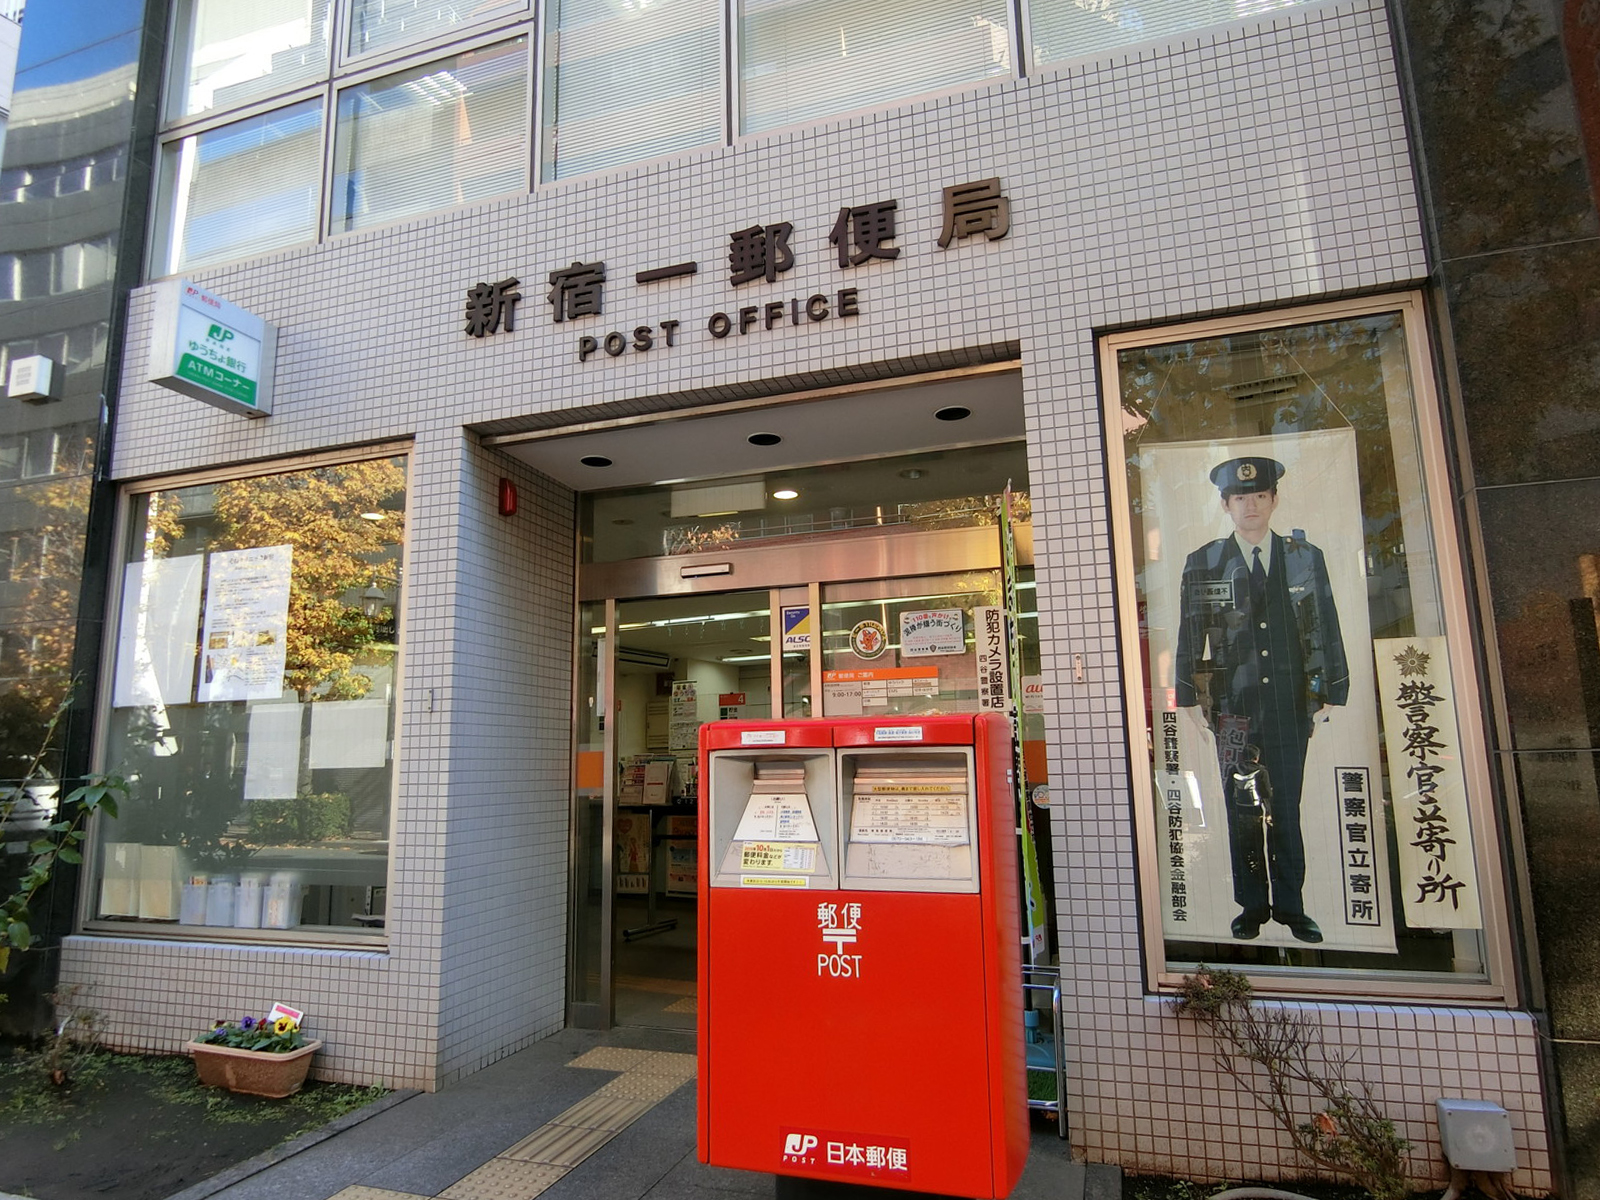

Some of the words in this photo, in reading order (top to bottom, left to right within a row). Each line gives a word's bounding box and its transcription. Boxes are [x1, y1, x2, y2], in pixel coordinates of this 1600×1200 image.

[464, 177, 1009, 338] 新宿一郵便局
[579, 320, 680, 362] POST
[708, 287, 859, 338] OFFICE
[188, 340, 247, 373] ゆうちょ銀行
[188, 360, 250, 390] ATMコーナー
[978, 654, 990, 707] 四谷警察署
[985, 609, 1005, 709] 防犯カメラ設置店
[1162, 711, 1188, 923] 四谷警察署・四谷防犯協会金融部会
[1395, 680, 1466, 911] 警察官立寄り所
[1342, 772, 1373, 920] 警察官立寄所
[817, 902, 862, 930] 郵便
[817, 954, 862, 978] POST
[782, 1155, 816, 1165] POST
[827, 1141, 908, 1171] 日本郵便
